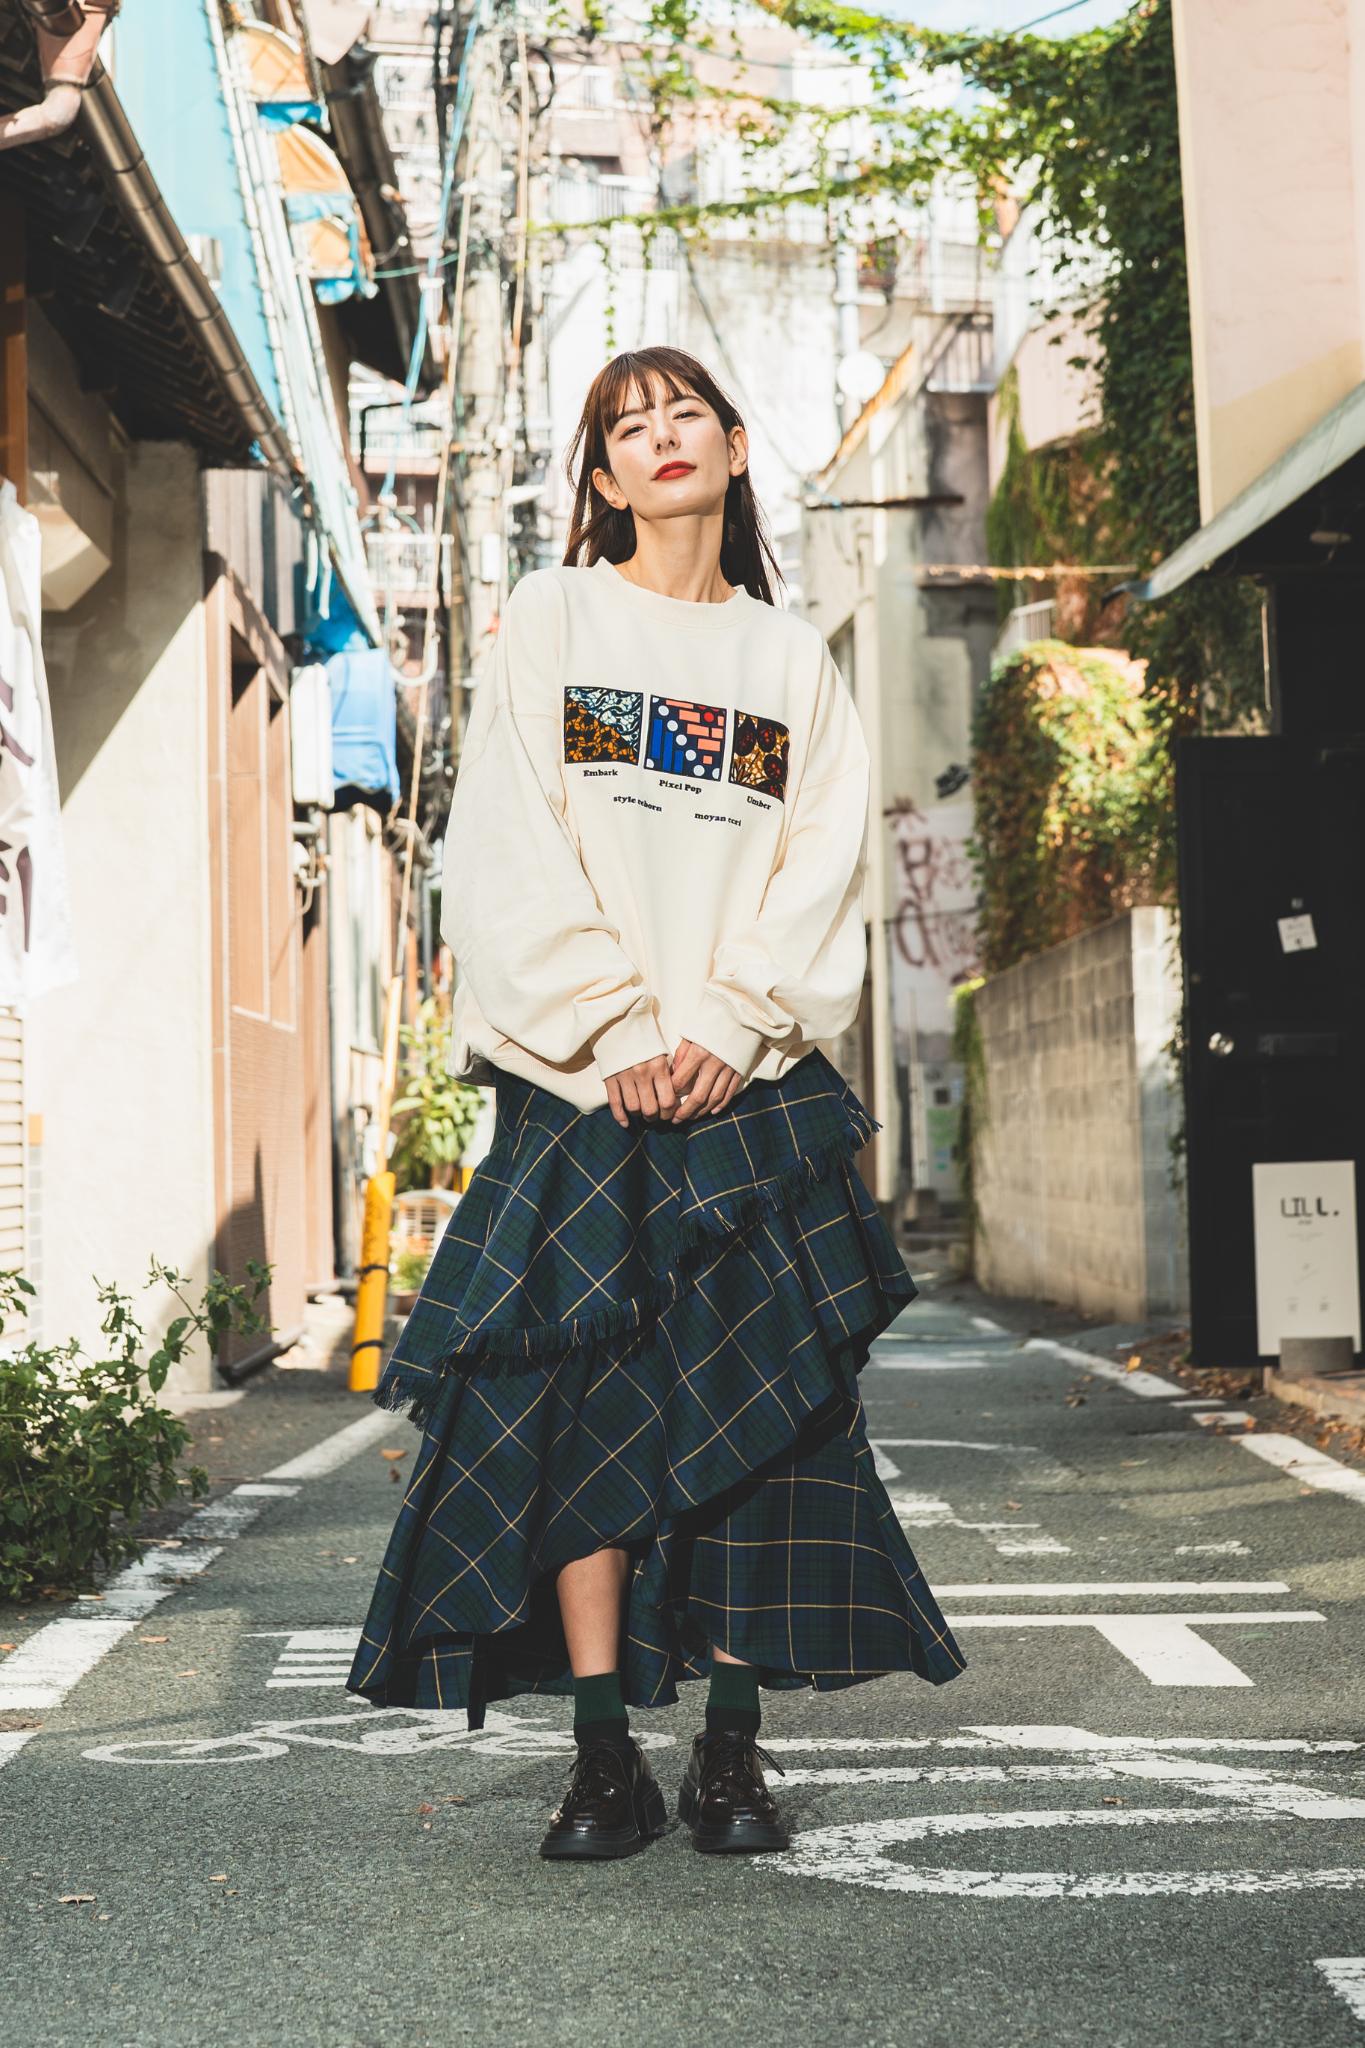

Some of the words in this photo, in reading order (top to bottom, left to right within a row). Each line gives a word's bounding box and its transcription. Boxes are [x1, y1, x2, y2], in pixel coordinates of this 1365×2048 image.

[582, 769, 618, 777] Embark
[658, 779, 683, 790] Pixel
[684, 783, 702, 794] Pop
[613, 795, 636, 804] style
[746, 795, 771, 810] Umber
[694, 813, 726, 822] moyan
